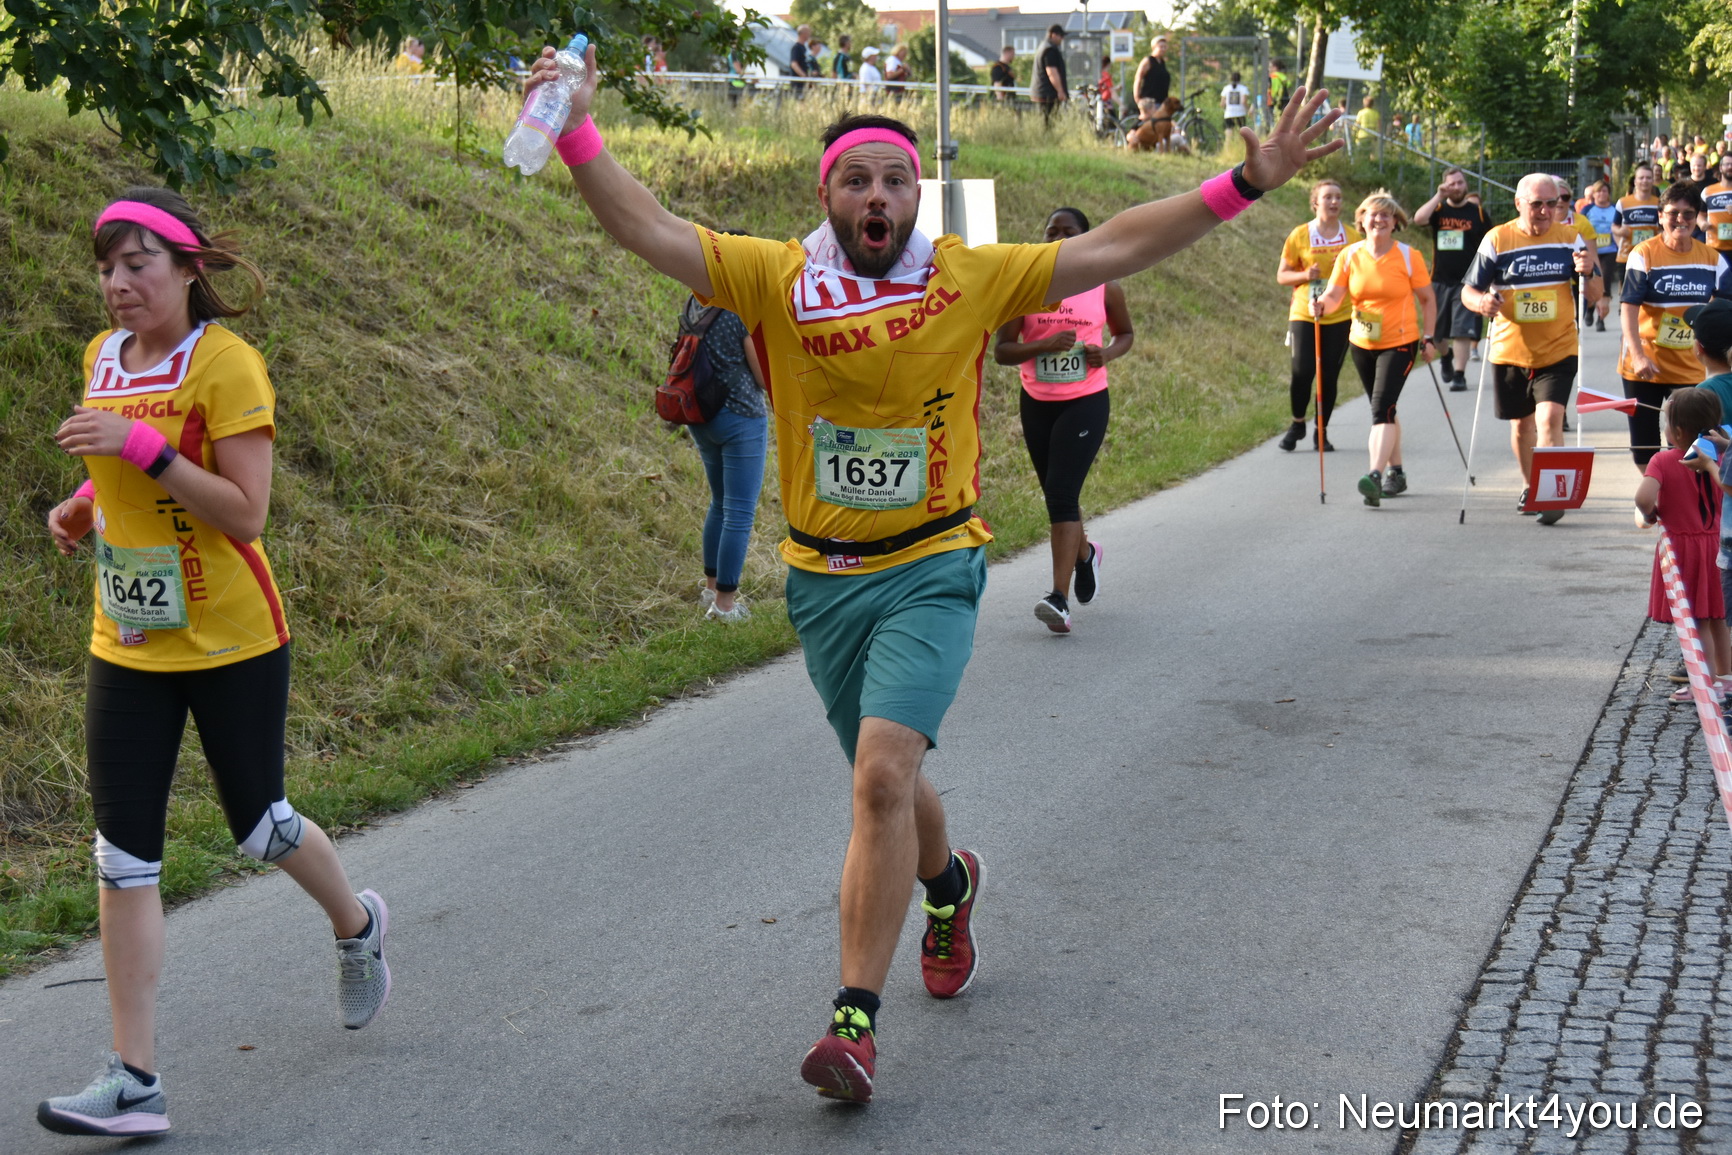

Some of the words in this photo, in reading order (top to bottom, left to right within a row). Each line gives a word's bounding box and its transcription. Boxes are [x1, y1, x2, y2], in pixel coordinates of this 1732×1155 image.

[1518, 260, 1564, 273] Fischer
[1664, 281, 1707, 291] Fischer
[1059, 306, 1073, 315] Die
[1523, 301, 1548, 314] 786
[802, 325, 877, 357] MAX
[885, 286, 961, 342] BÖGL
[1668, 327, 1692, 340] 744
[1040, 356, 1080, 372] 1120
[121, 398, 182, 419] BÖGL
[829, 439, 872, 453] firmenlauf
[898, 450, 919, 458] 2019
[827, 454, 911, 488] 1637
[840, 485, 866, 496] Müller
[868, 488, 896, 497] Daniel
[841, 493, 854, 501] Bögl
[103, 568, 170, 607] 1642
[141, 608, 166, 616] Sarah
